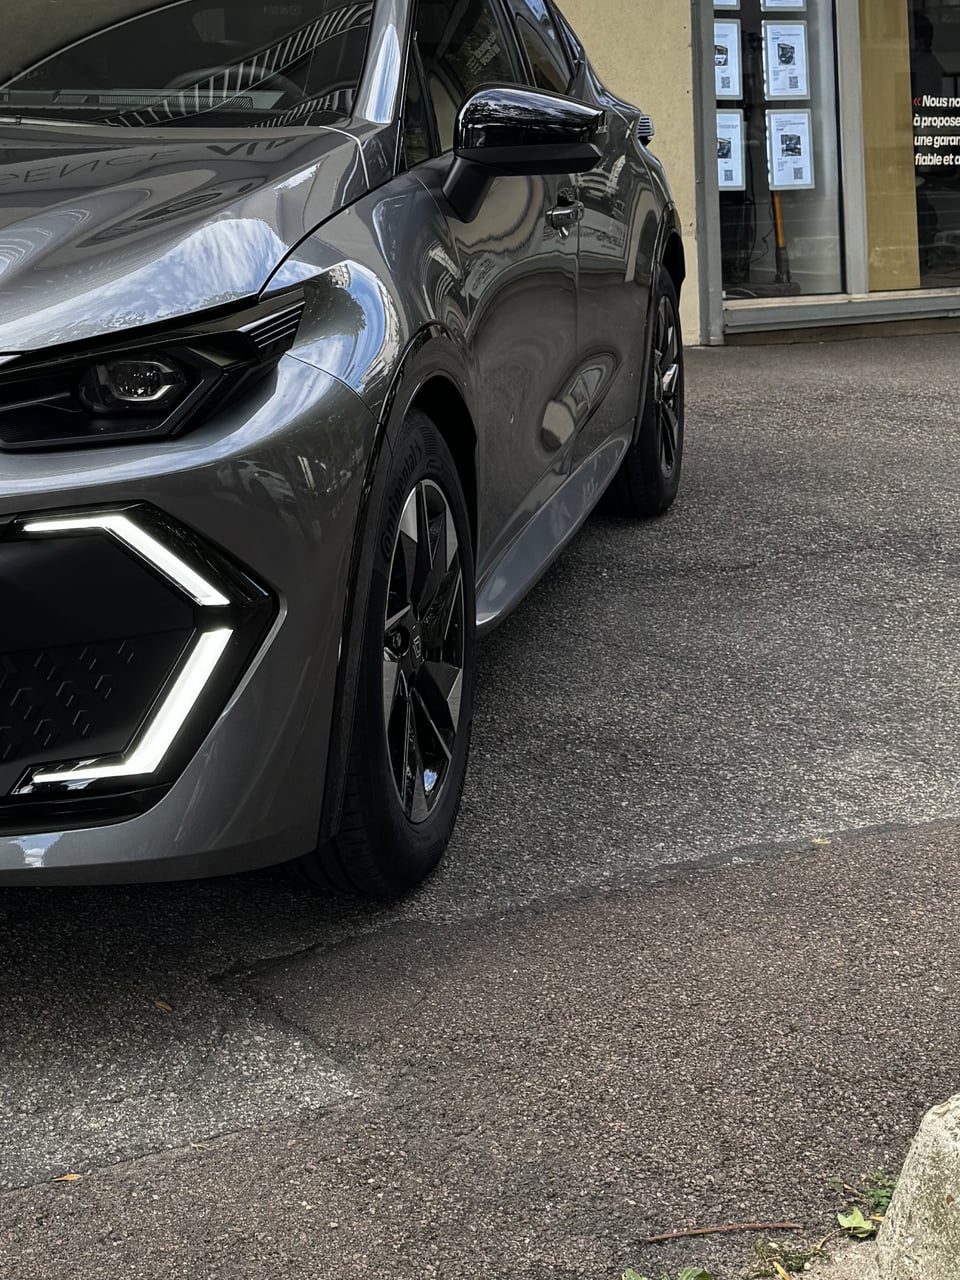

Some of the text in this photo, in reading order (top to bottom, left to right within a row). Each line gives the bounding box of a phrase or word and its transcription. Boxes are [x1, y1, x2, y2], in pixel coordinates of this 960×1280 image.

[922, 95, 948, 107] Nous
[913, 113, 960, 129] à propose
[914, 135, 960, 148] une garan
[915, 153, 942, 166] fiable
[943, 153, 954, 166] et
